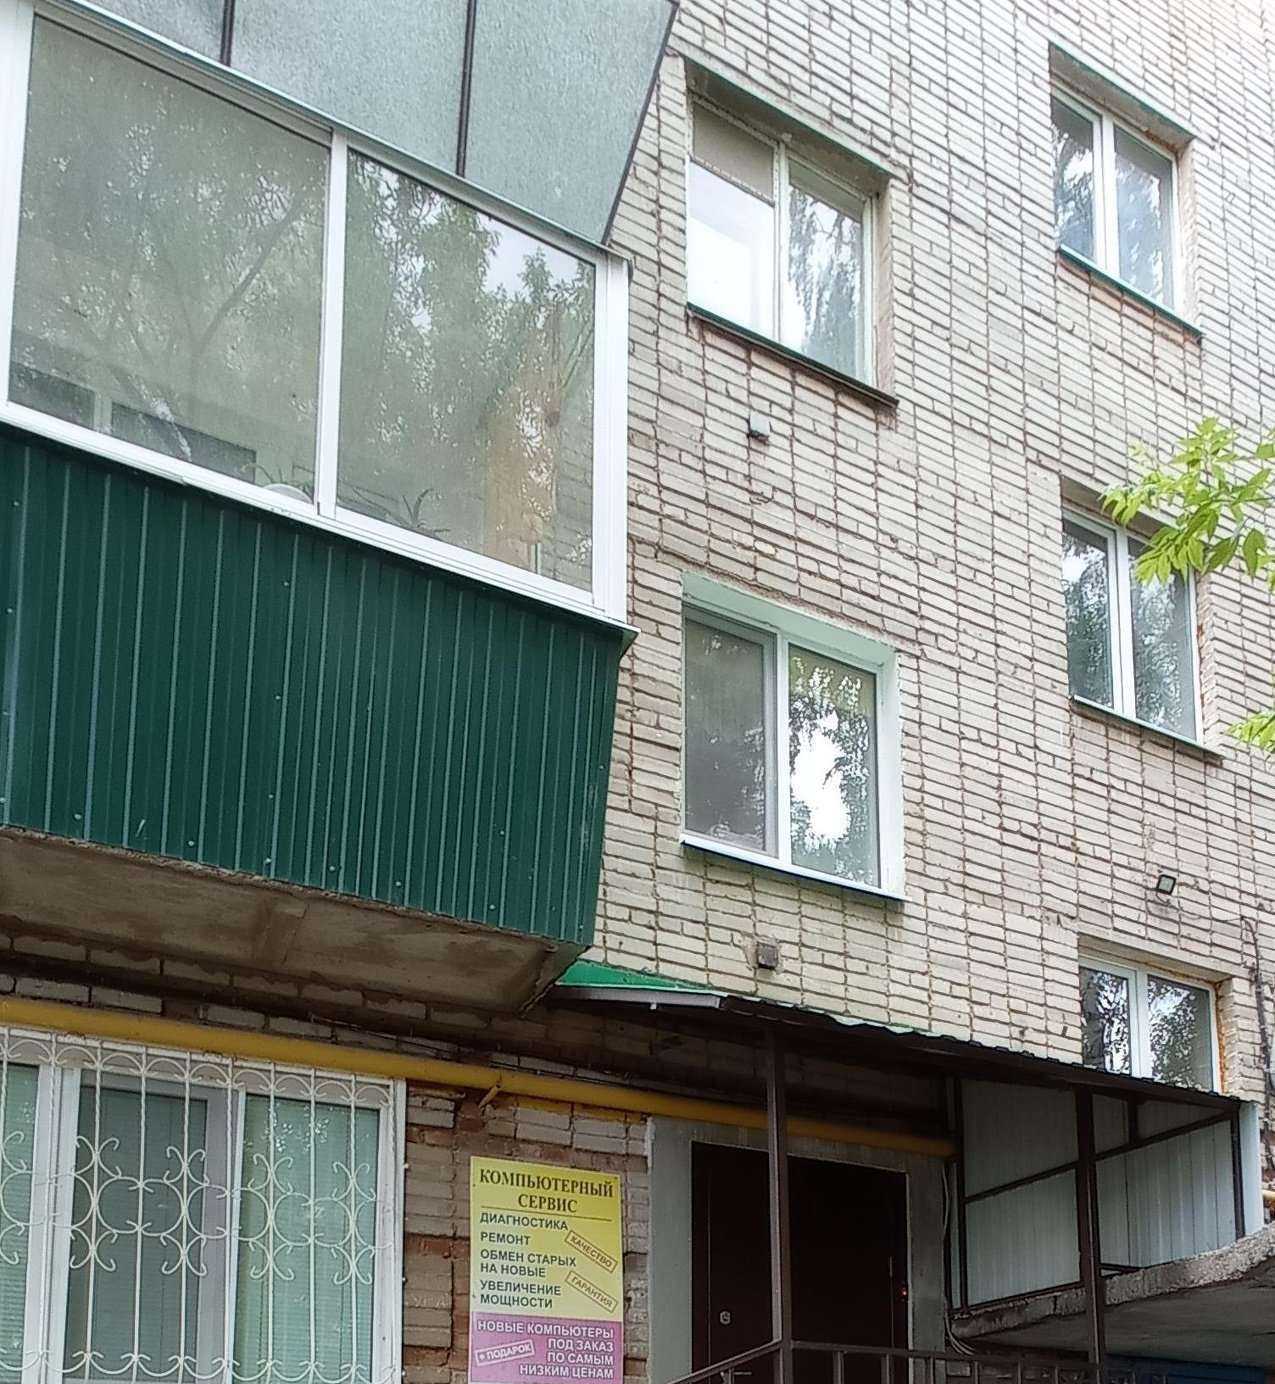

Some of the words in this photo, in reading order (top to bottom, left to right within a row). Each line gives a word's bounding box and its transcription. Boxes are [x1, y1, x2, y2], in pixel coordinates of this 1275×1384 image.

[480, 1168, 614, 1198] КОМПЬЮТЕРНЫЙ
[518, 1194, 578, 1213] СЕРВИС
[480, 1213, 568, 1231] ДИАГНОСТИКА
[481, 1232, 531, 1246] РЕМОНТ
[481, 1249, 524, 1262] ОБМЕН
[527, 1254, 576, 1267] СТАРЫХ
[569, 1235, 613, 1268] КАЧЕСТВО
[481, 1264, 497, 1274] НА
[501, 1265, 546, 1278] НОВЫЕ
[480, 1279, 561, 1295] УВЕЛИЧЕНИЕ
[571, 1276, 613, 1308] ГАРАНТИЯ
[480, 1294, 553, 1309] МОЩНОСТИ
[477, 1321, 523, 1333] НОВЫЕ
[527, 1325, 614, 1339] КОМПЬЮТЕРЫ
[486, 1344, 531, 1360] ПОДАРОК
[548, 1339, 574, 1351] ПОД
[577, 1340, 614, 1352] ЗАКАЗ
[547, 1352, 566, 1363] ПО
[568, 1353, 614, 1365] САМЫМ
[520, 1365, 570, 1377] НИЗКИМ
[572, 1368, 614, 1379] ЦЕНАМ
